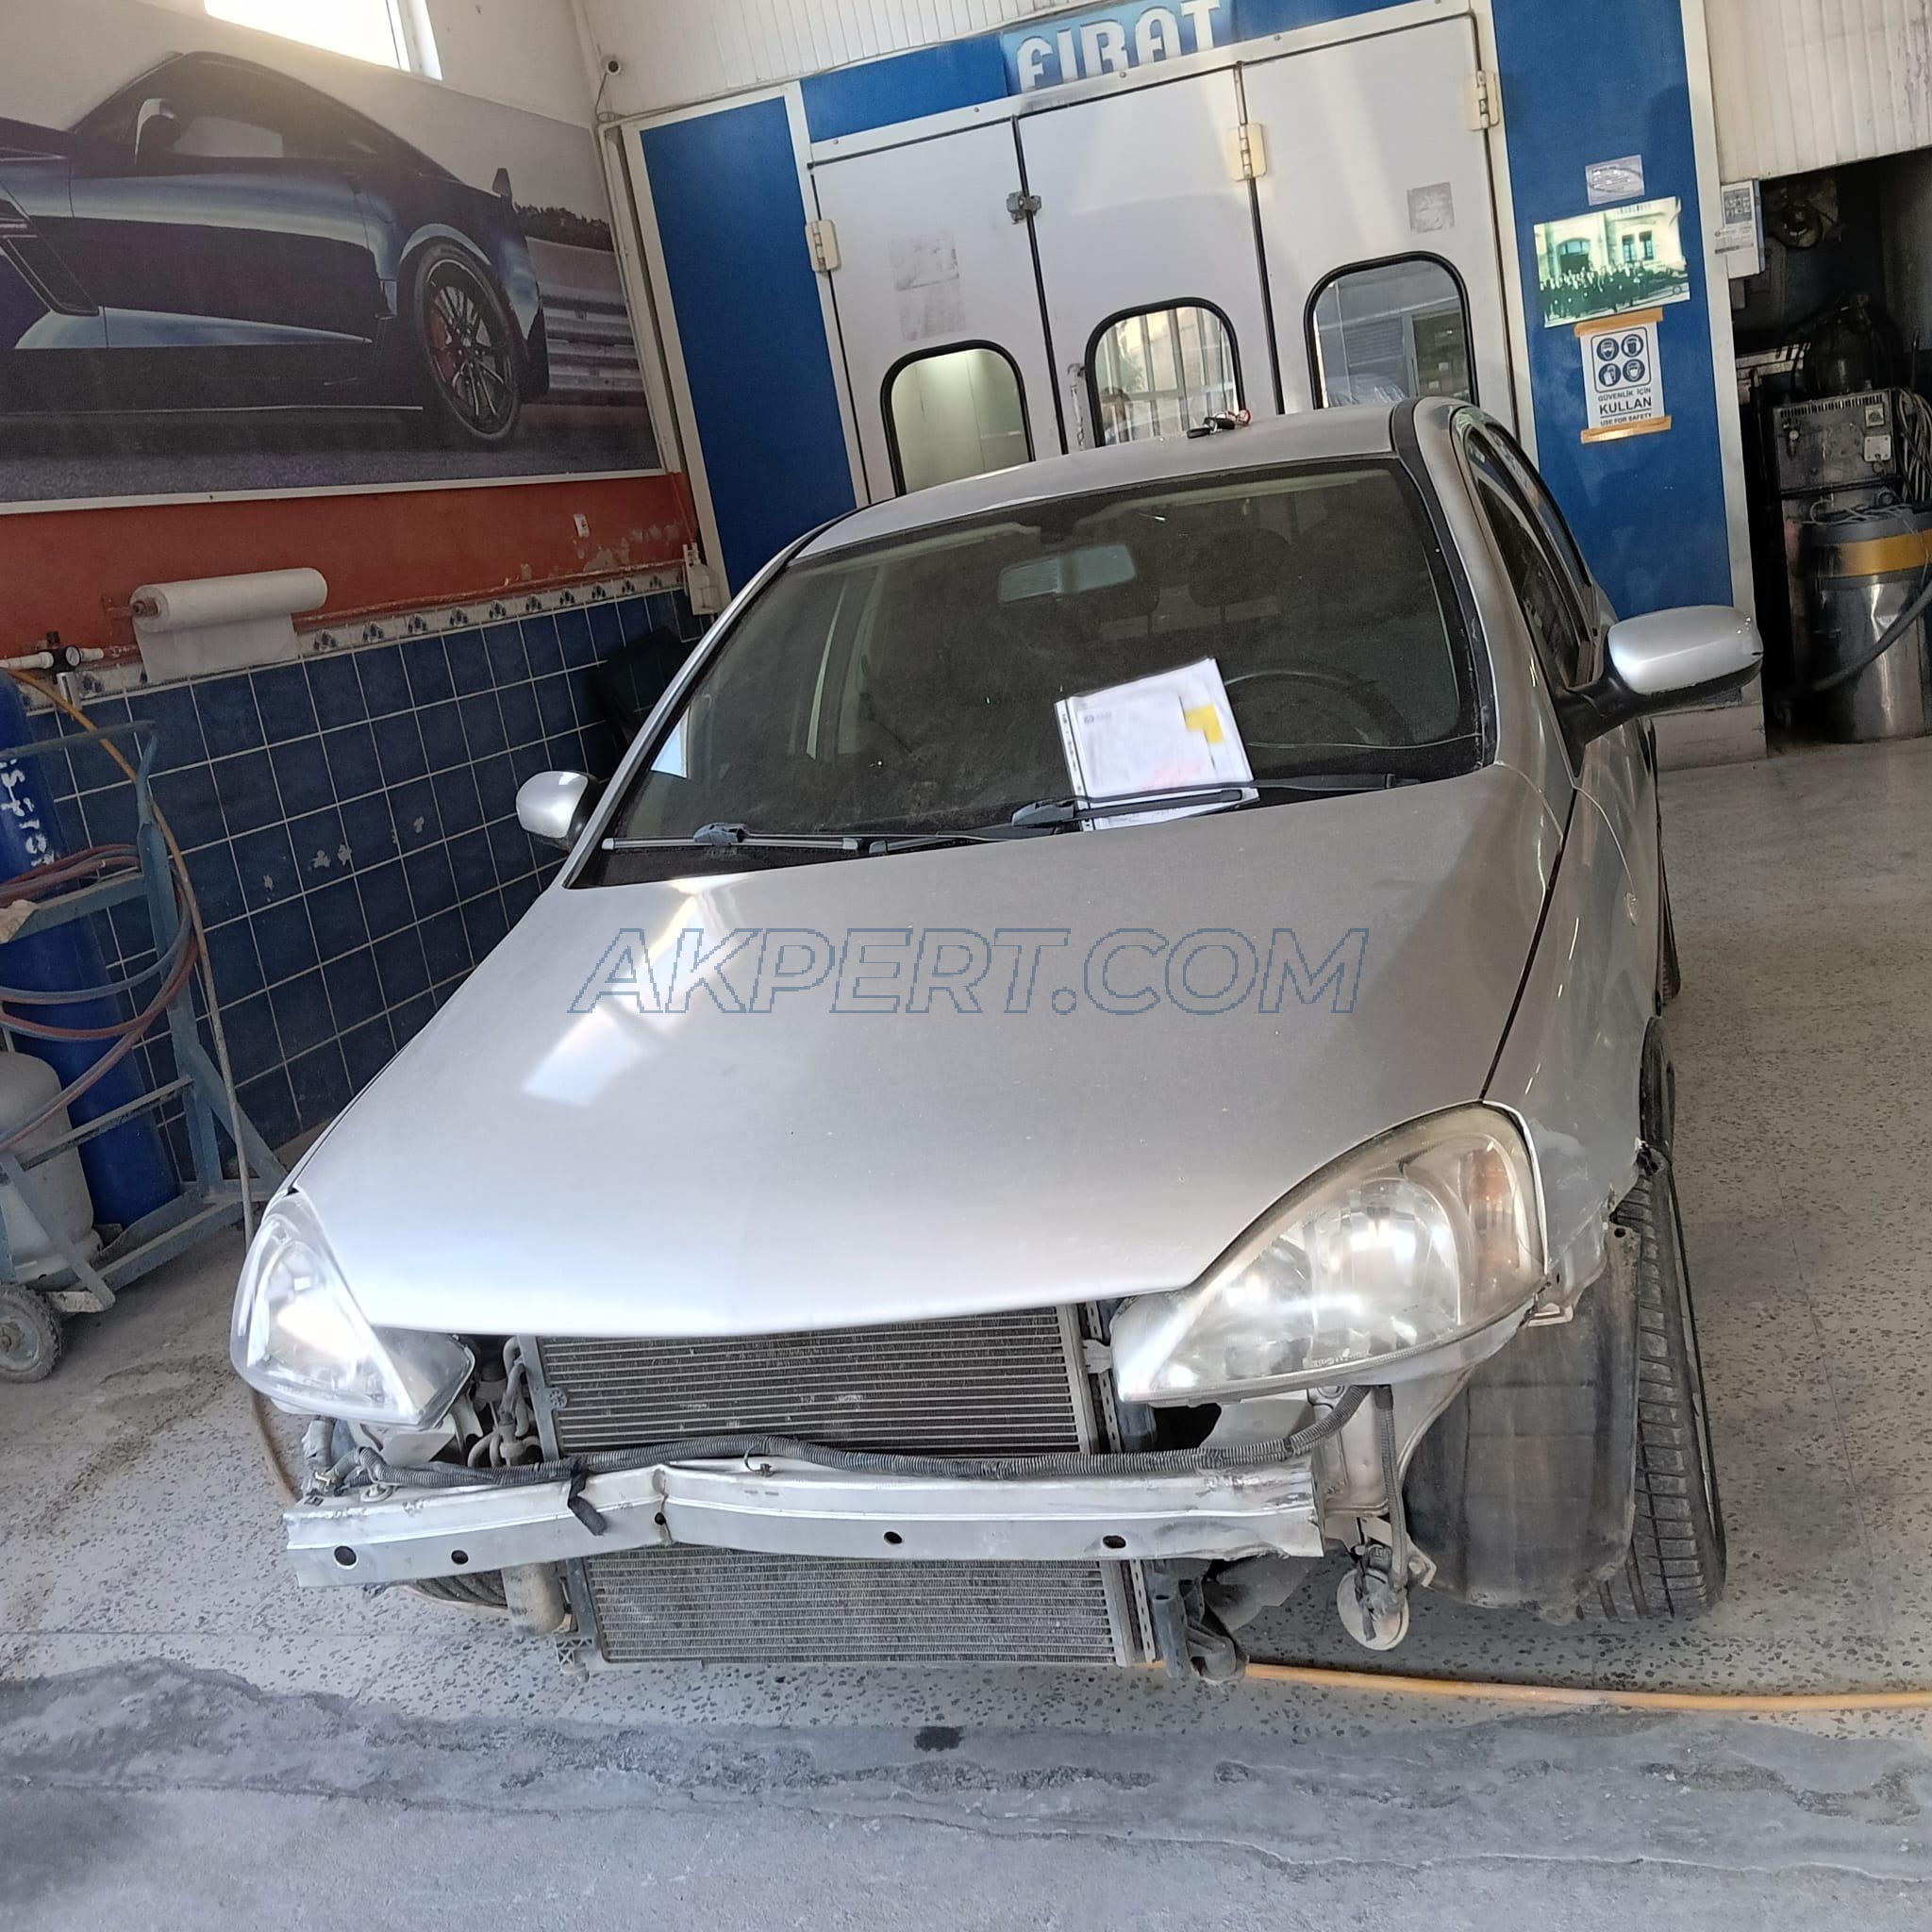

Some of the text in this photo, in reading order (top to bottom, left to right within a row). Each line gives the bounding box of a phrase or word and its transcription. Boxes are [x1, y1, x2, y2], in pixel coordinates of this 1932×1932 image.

[1016, 0, 1220, 91] FIRAT
[1598, 387, 1651, 402] GÜVENLİK İÇİN
[1599, 396, 1652, 414] KULLAN
[1614, 416, 1627, 425] FOR
